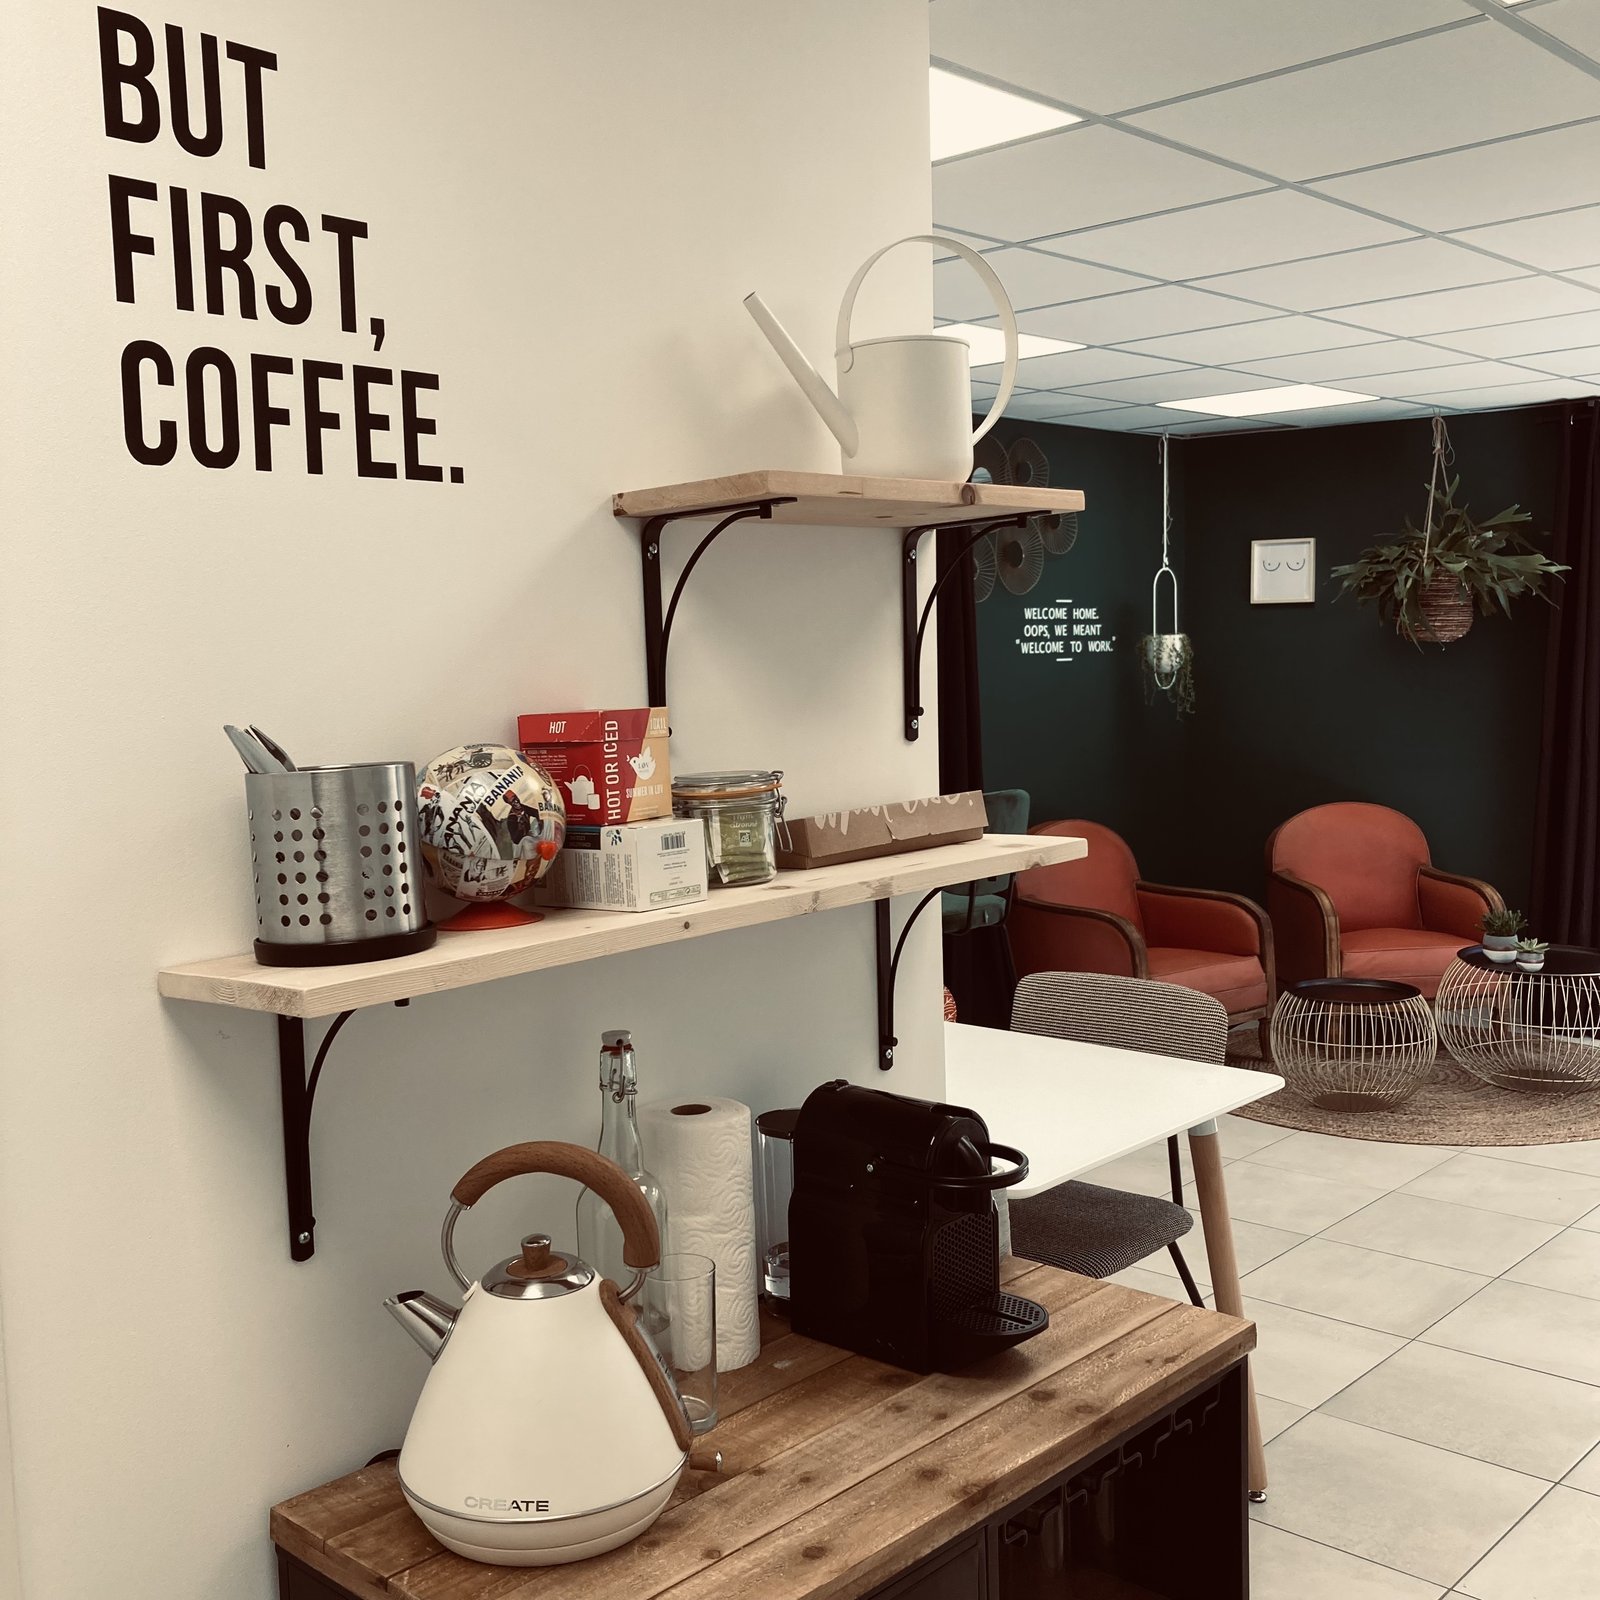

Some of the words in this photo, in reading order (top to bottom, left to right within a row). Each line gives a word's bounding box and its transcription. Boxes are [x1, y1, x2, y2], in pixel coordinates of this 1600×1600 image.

[97, 6, 278, 170] BUT
[108, 174, 386, 352] FIRST,
[120, 339, 465, 485] COFFEE.
[1024, 607, 1068, 620] WELCOME
[1072, 607, 1100, 620] HOME.
[1023, 624, 1050, 639] OOPS,
[1054, 624, 1068, 636] WE
[1072, 623, 1102, 636] MEANT
[1070, 641, 1083, 653] TO
[549, 721, 567, 734] HOT
[603, 720, 619, 759] ICED
[484, 764, 525, 808] BANANIA
[605, 761, 620, 785] OR
[606, 788, 621, 821] HOT
[463, 1496, 550, 1513] CREATE
